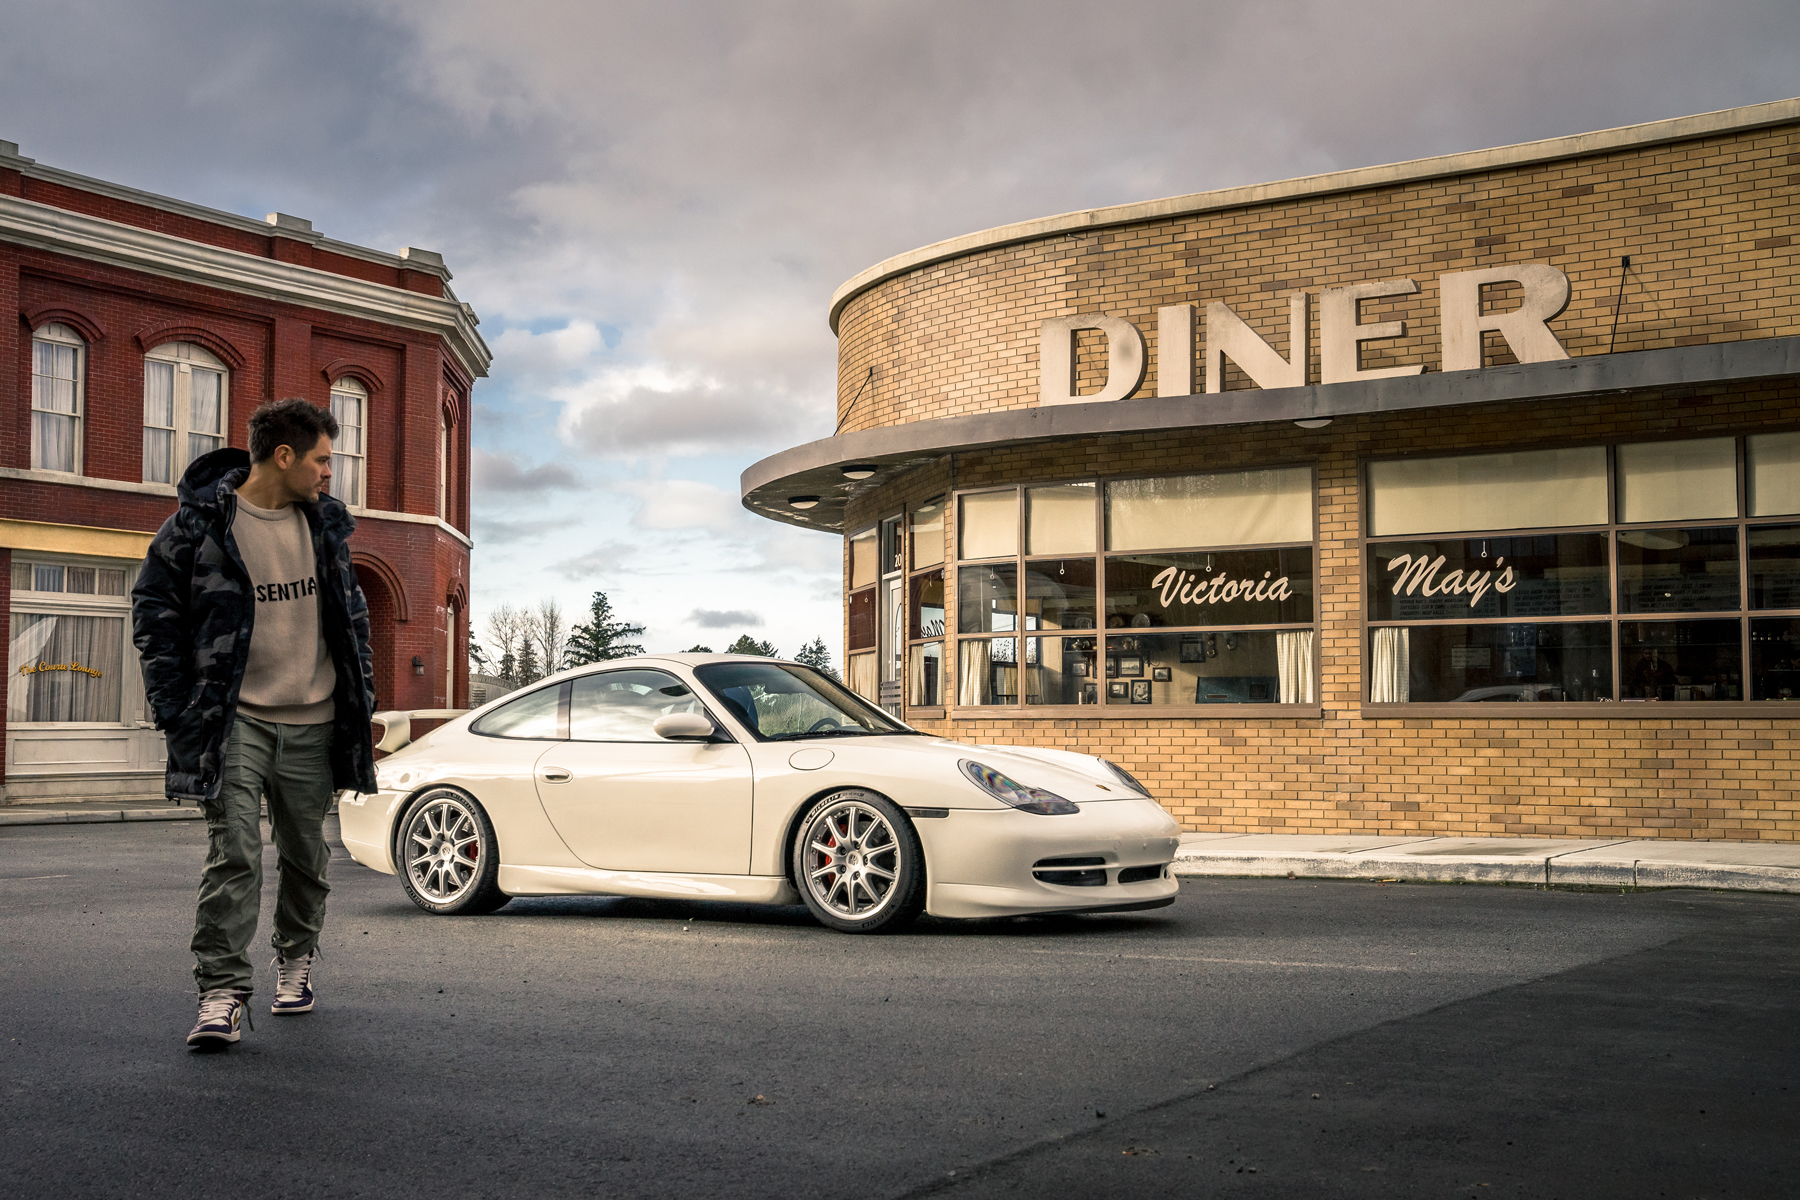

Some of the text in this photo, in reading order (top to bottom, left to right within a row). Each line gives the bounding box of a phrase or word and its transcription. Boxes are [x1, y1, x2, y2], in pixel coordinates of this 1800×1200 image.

[1040, 264, 1572, 406] DINER
[255, 576, 317, 602] SENTIA
[1152, 566, 1292, 608] Victoria
[1387, 553, 1517, 608] May's
[19, 664, 37, 677] The
[69, 661, 103, 679] Lounge
